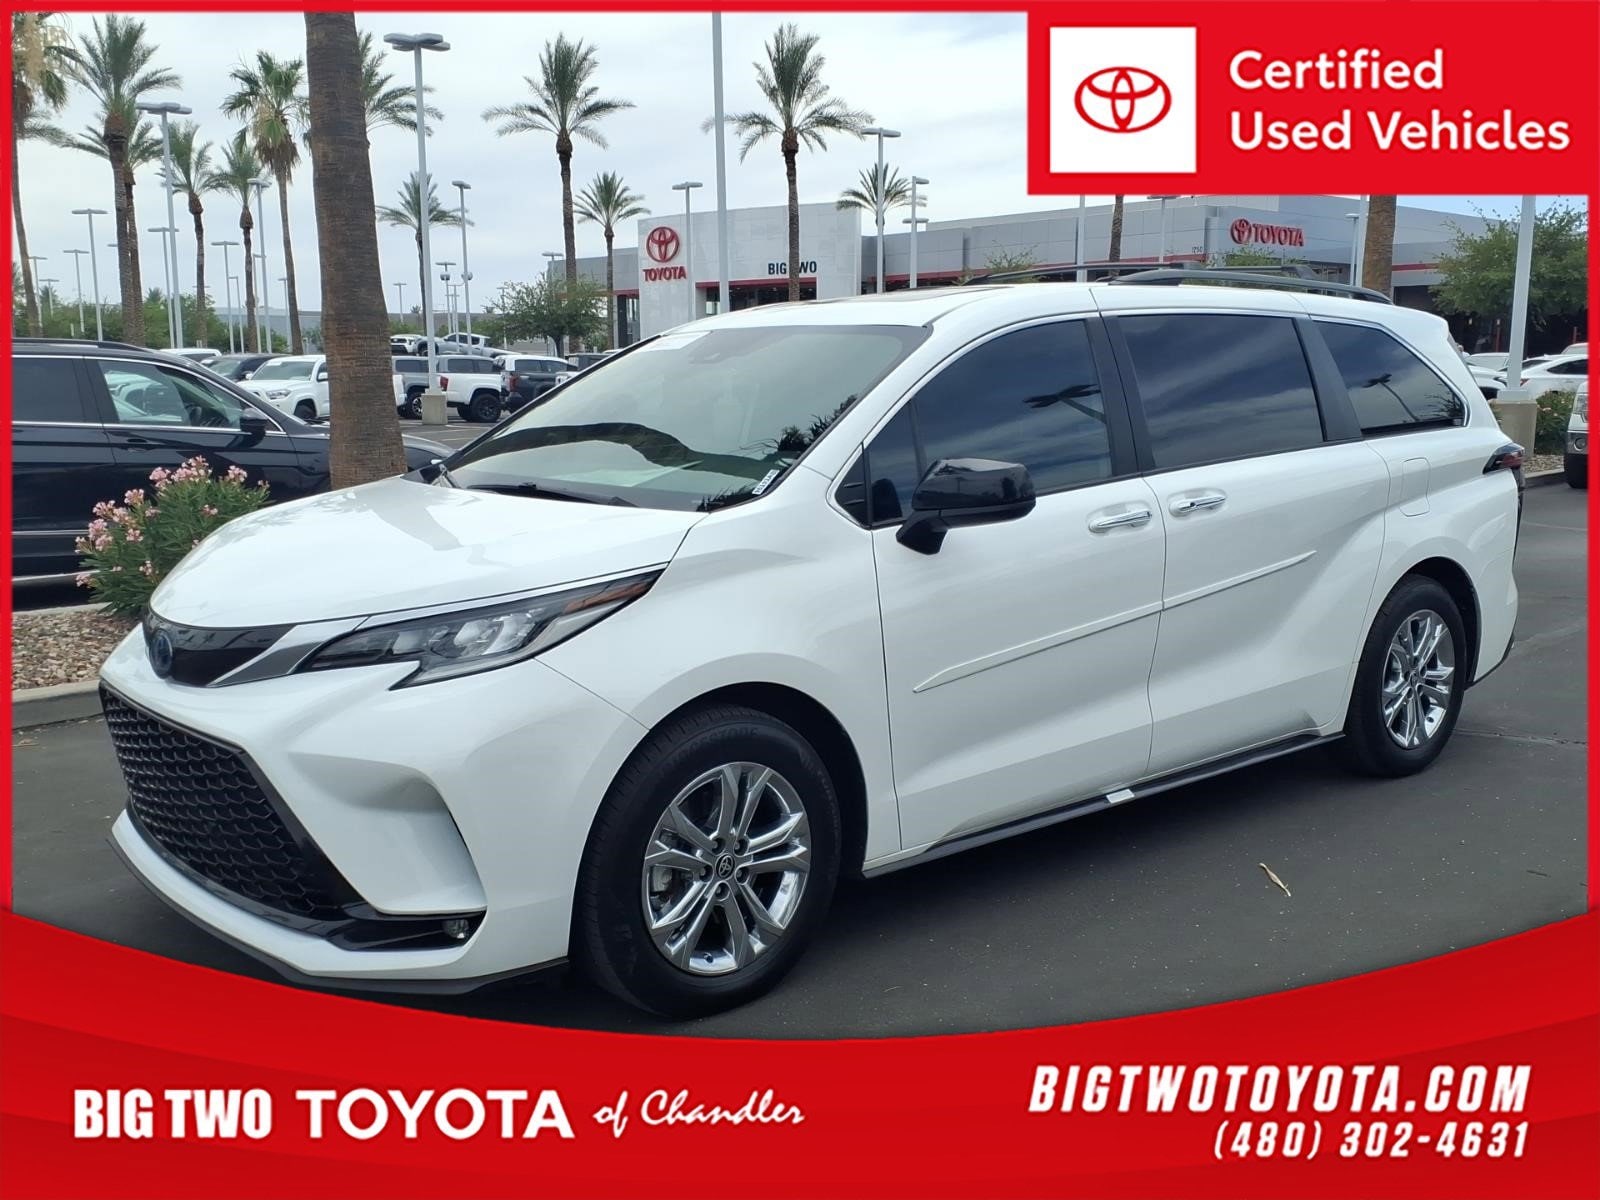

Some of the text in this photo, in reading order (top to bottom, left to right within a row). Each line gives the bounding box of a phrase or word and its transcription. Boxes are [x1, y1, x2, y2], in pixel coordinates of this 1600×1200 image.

[1252, 223, 1304, 247] TOYOTA
[643, 265, 687, 282] TOYOTA
[768, 260, 817, 275] BIG WO
